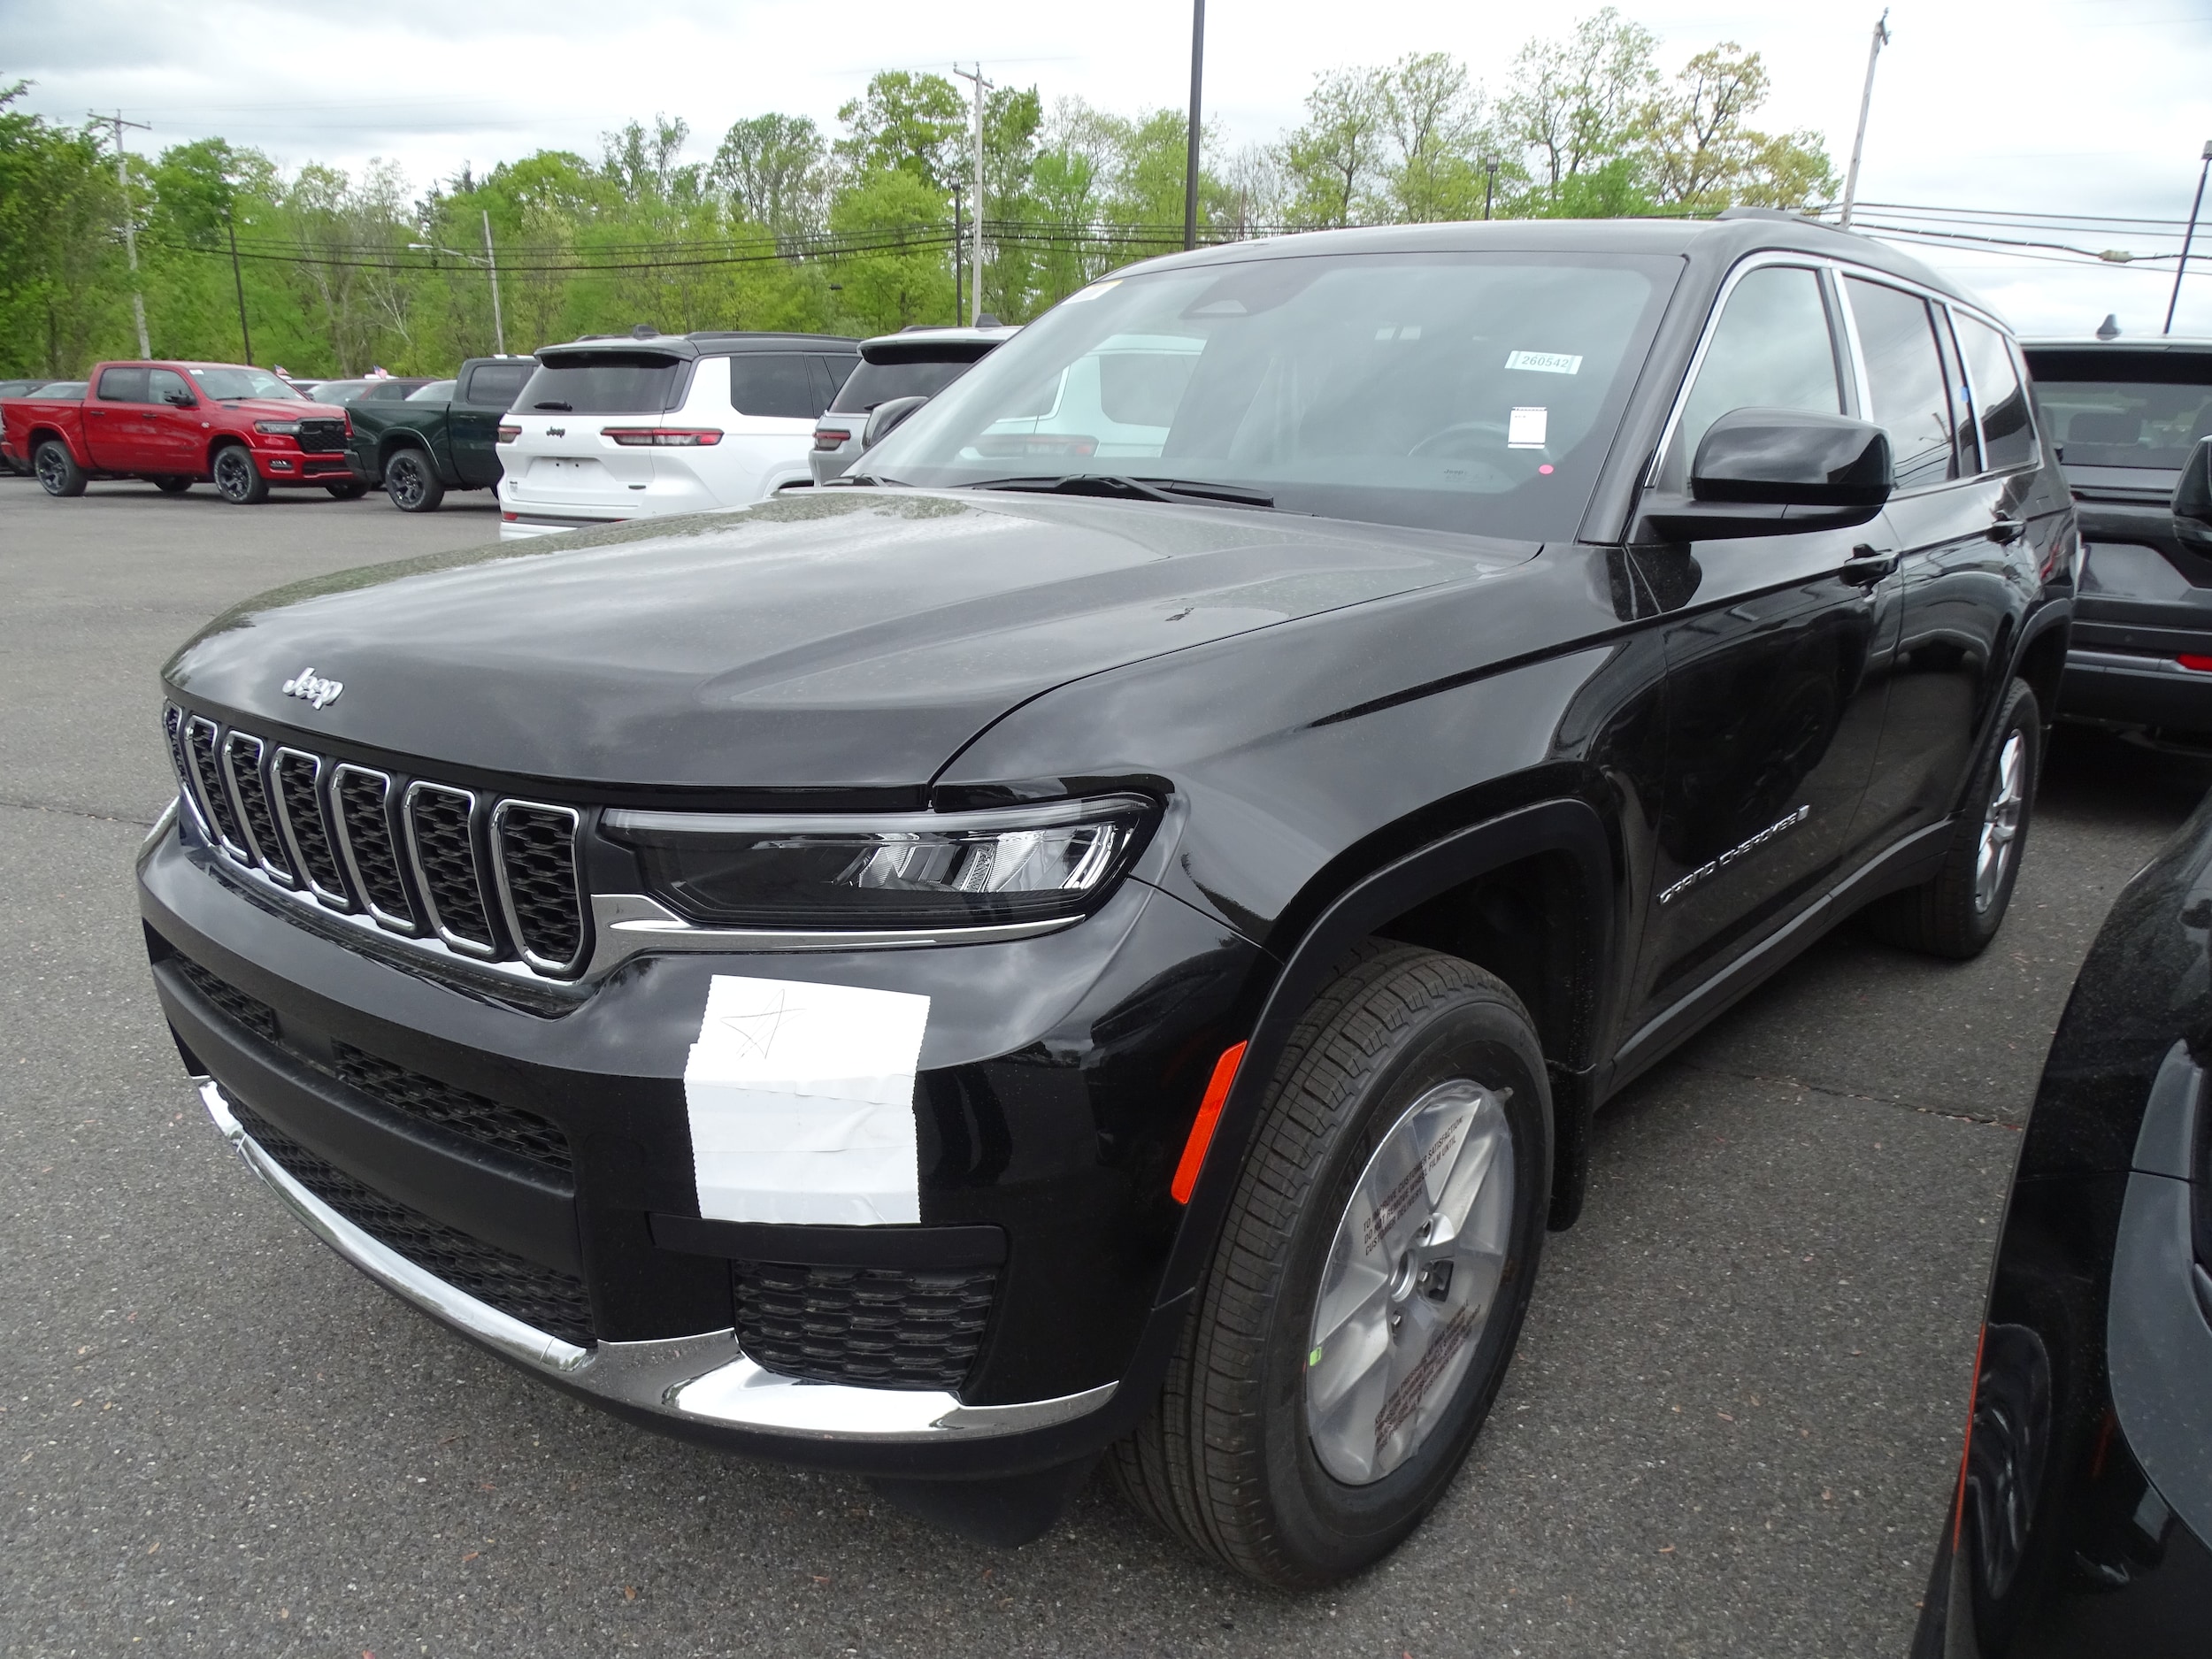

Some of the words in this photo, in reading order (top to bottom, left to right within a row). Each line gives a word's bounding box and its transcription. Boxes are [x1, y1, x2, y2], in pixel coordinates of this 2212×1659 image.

[1522, 356, 1569, 368] 260542
[546, 426, 565, 438] Jeep
[282, 667, 343, 710] Jeep
[1659, 860, 1717, 905] GRAND
[1719, 813, 1797, 866] CHEROKEE
